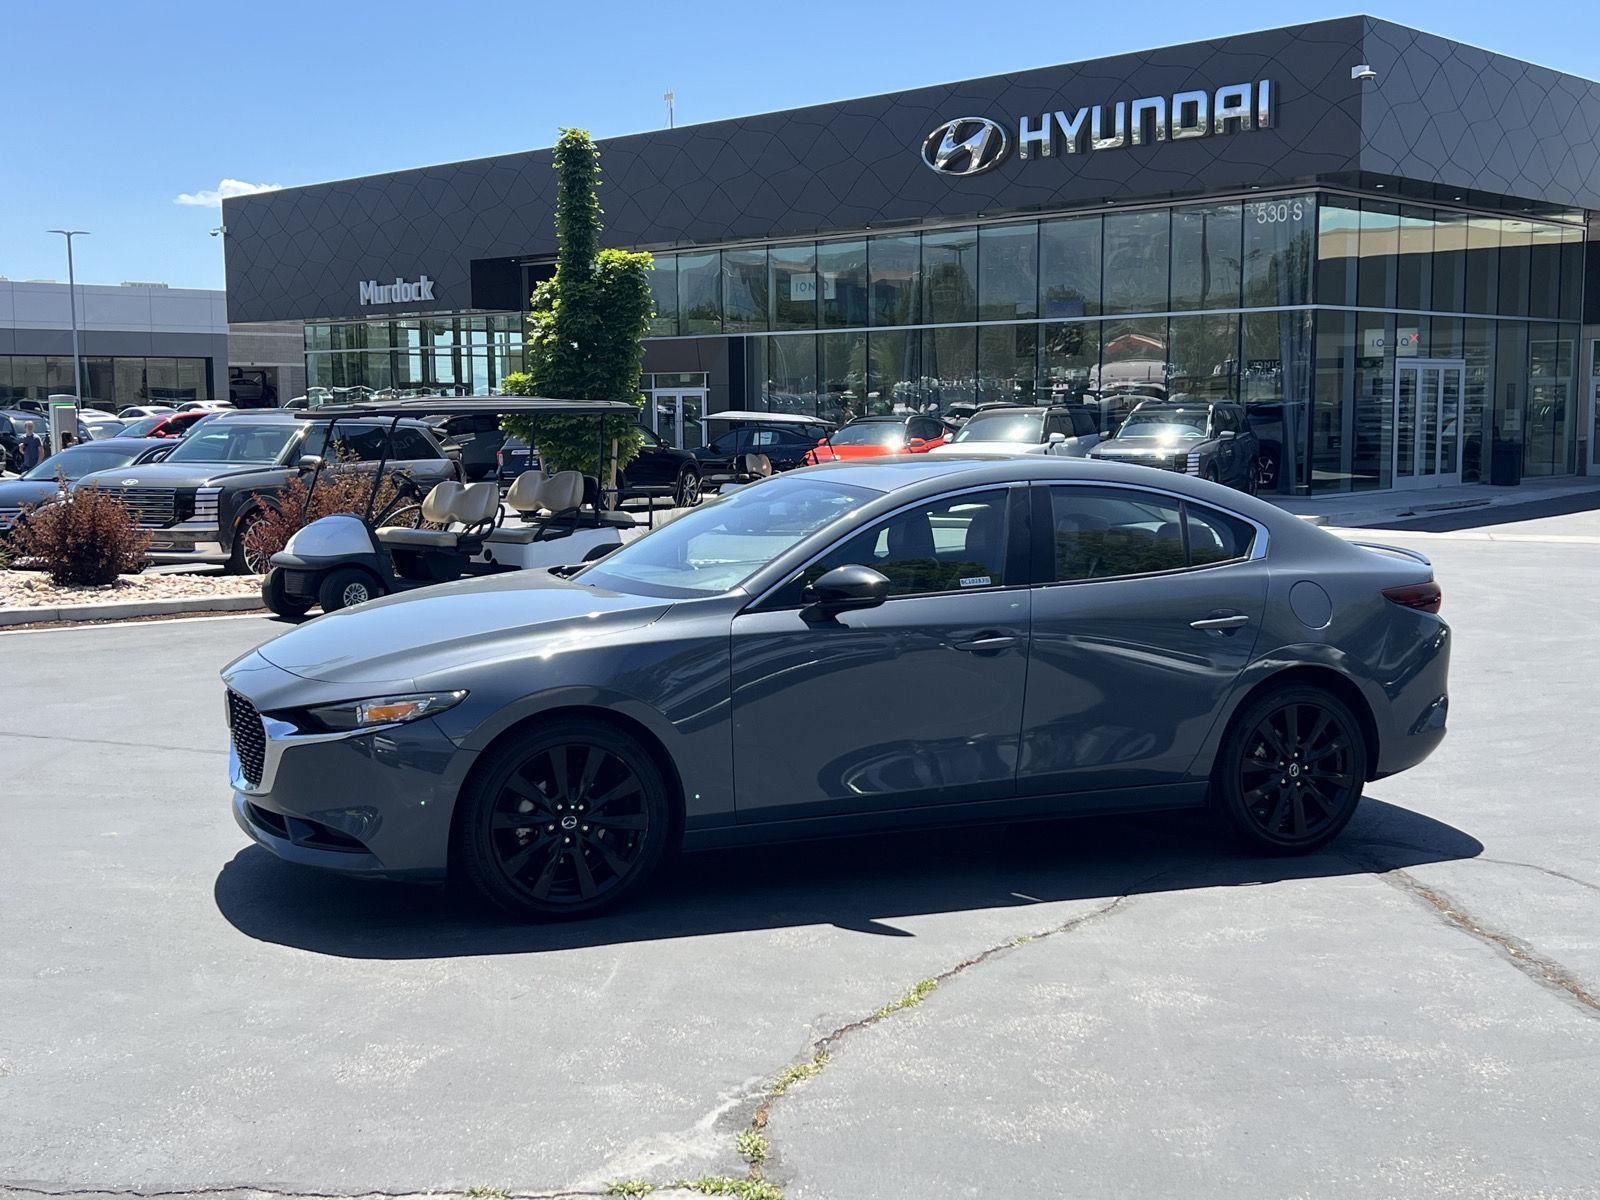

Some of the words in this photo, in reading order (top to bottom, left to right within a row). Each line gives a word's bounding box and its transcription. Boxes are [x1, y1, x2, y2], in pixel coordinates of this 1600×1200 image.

[1018, 79, 1272, 160] HYUNDAI
[1256, 204, 1288, 224] 530
[1292, 202, 1303, 221] S
[359, 275, 435, 306] Murdock
